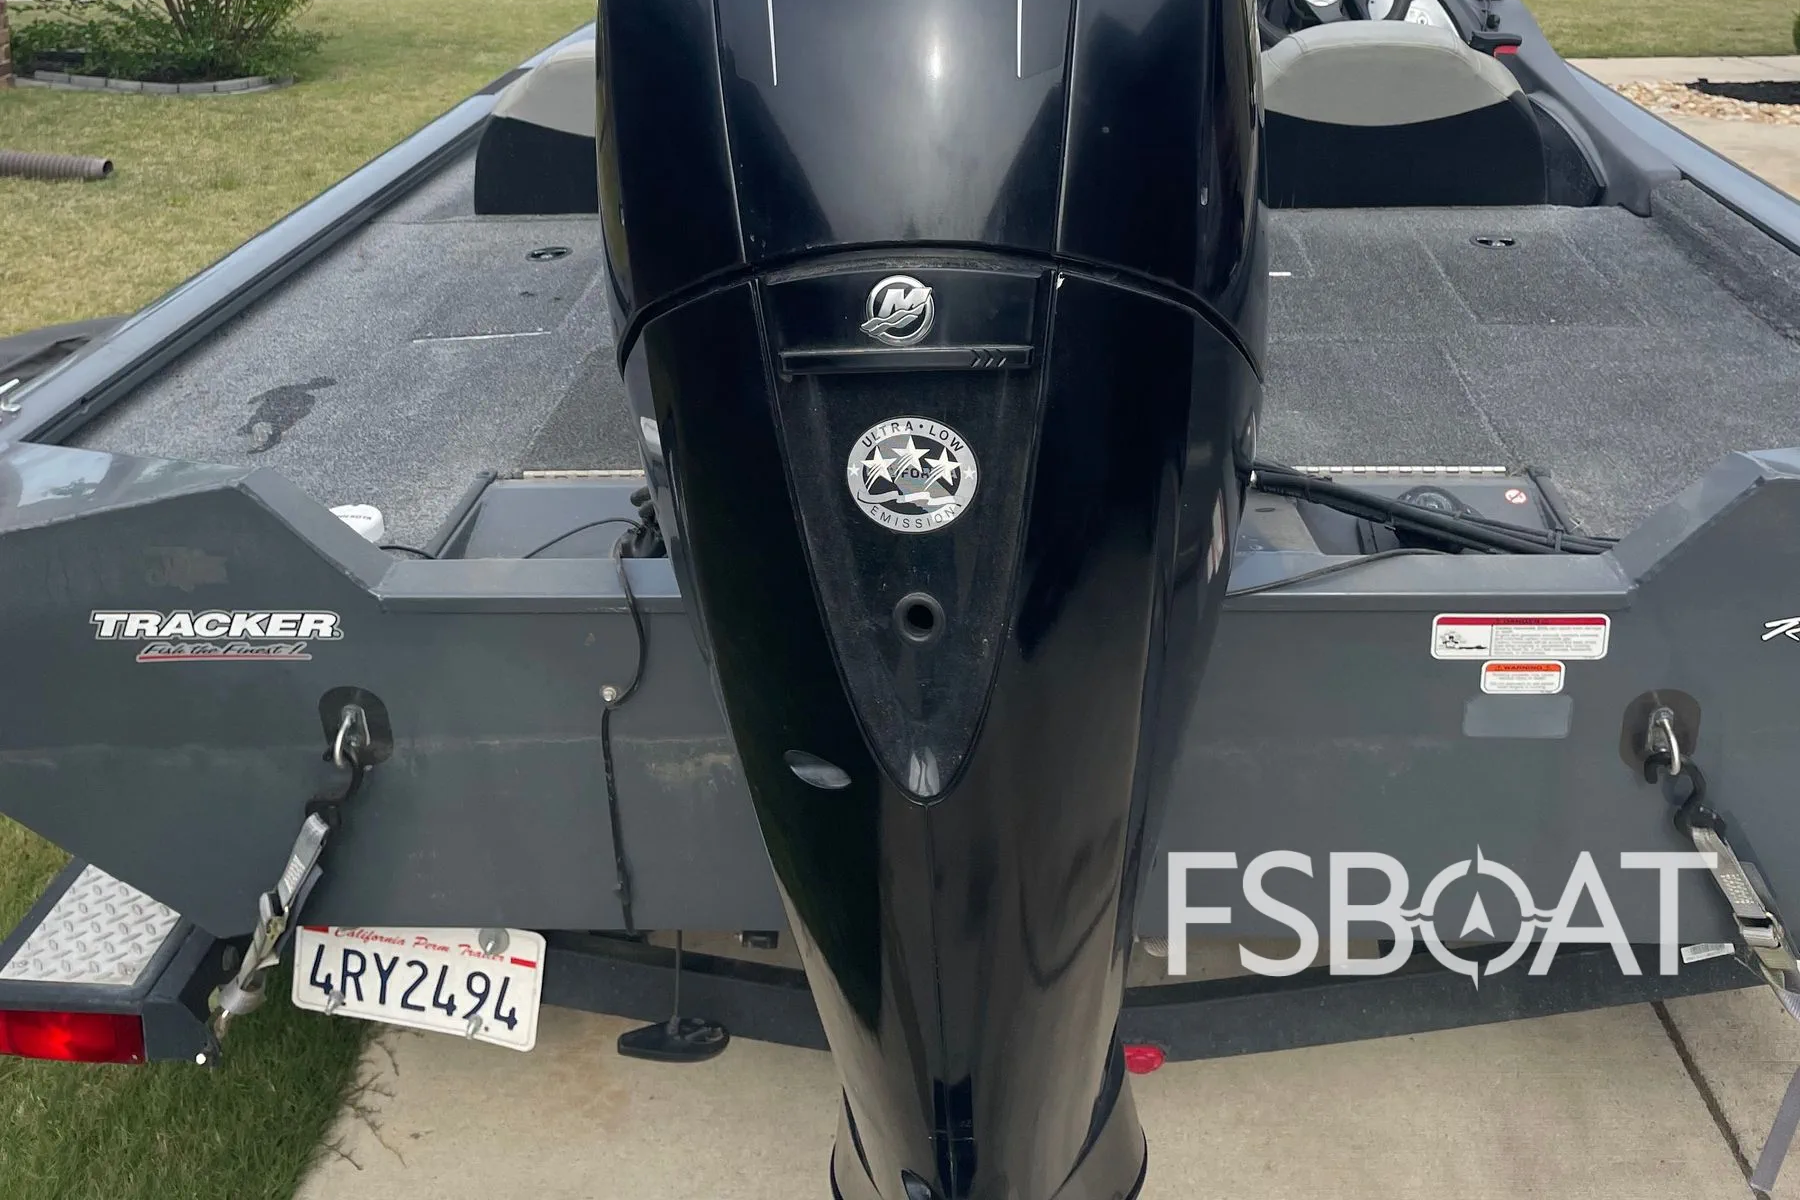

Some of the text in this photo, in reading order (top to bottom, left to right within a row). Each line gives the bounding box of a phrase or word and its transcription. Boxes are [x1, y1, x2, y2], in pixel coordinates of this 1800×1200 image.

[861, 420, 965, 452] ULTRA LOW
[91, 611, 338, 639] TRACKER
[143, 644, 186, 655] Fish
[190, 644, 218, 655] the
[334, 927, 406, 946] California
[412, 936, 450, 953] Perm
[310, 944, 518, 1030] 4RY2494
